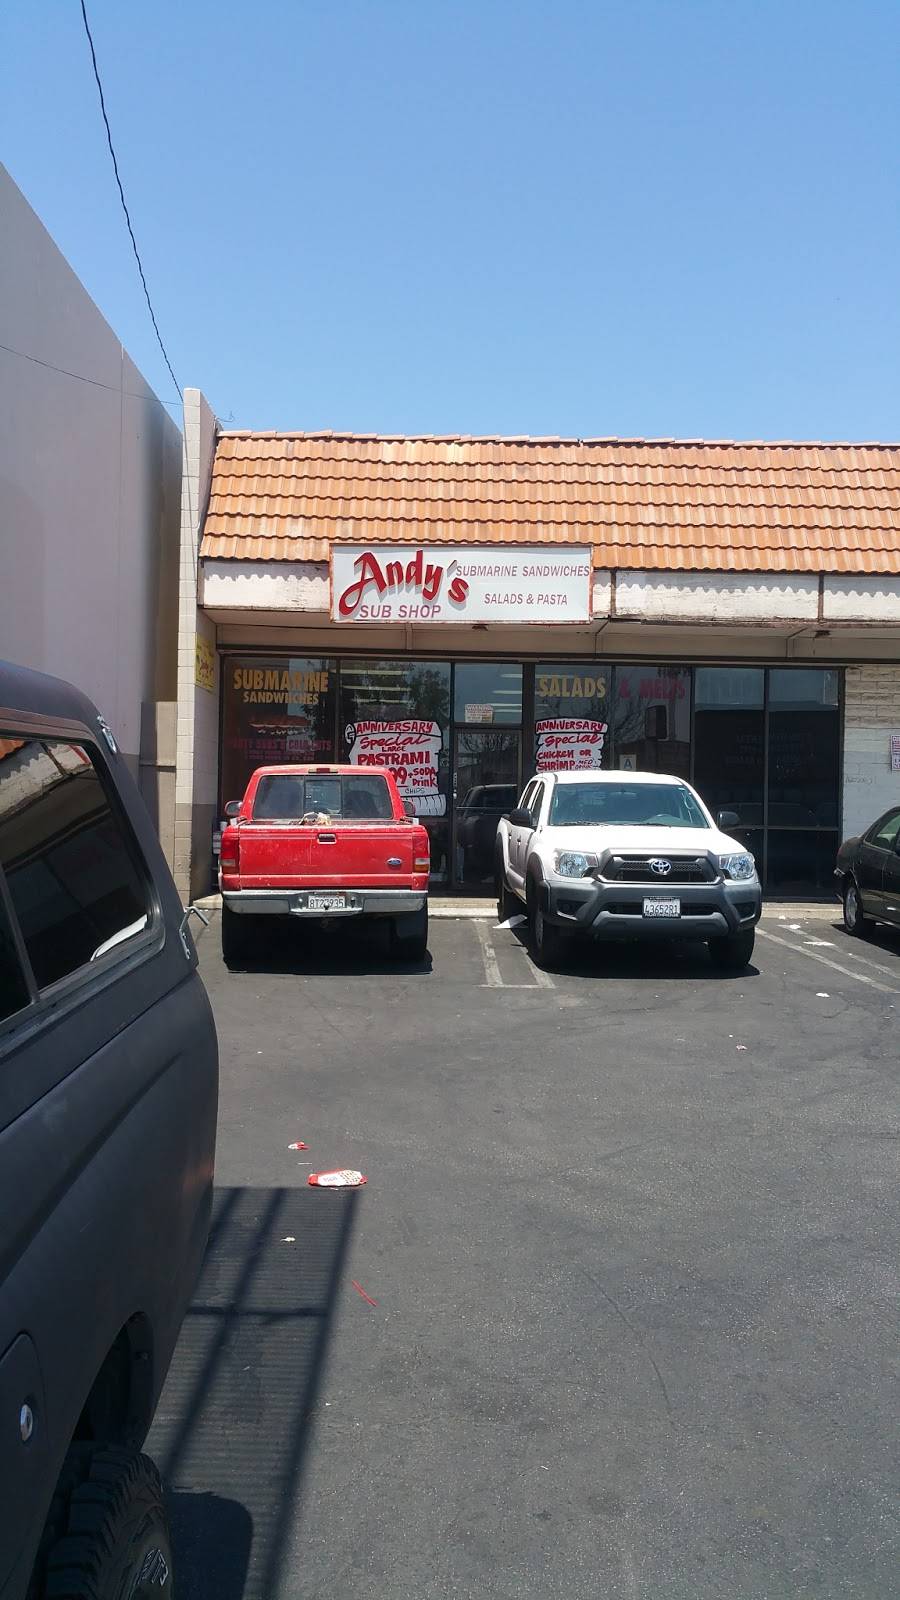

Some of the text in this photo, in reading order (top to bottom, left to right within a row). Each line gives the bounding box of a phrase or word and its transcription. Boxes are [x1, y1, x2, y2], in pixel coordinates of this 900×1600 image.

[456, 565, 590, 577] SUBMARINE SANDWICHES
[338, 550, 469, 616] Andy's
[484, 593, 568, 605] SALADS & PASTA
[359, 604, 441, 618] SUB SHOP
[233, 668, 329, 692] SUBMARINE
[538, 676, 606, 698] SALADS
[243, 691, 319, 704] SANDWICHES
[356, 721, 433, 734] ANNIVERSARY
[536, 719, 604, 732] ANNIVERSARY
[357, 751, 430, 766] PASTRAMI
